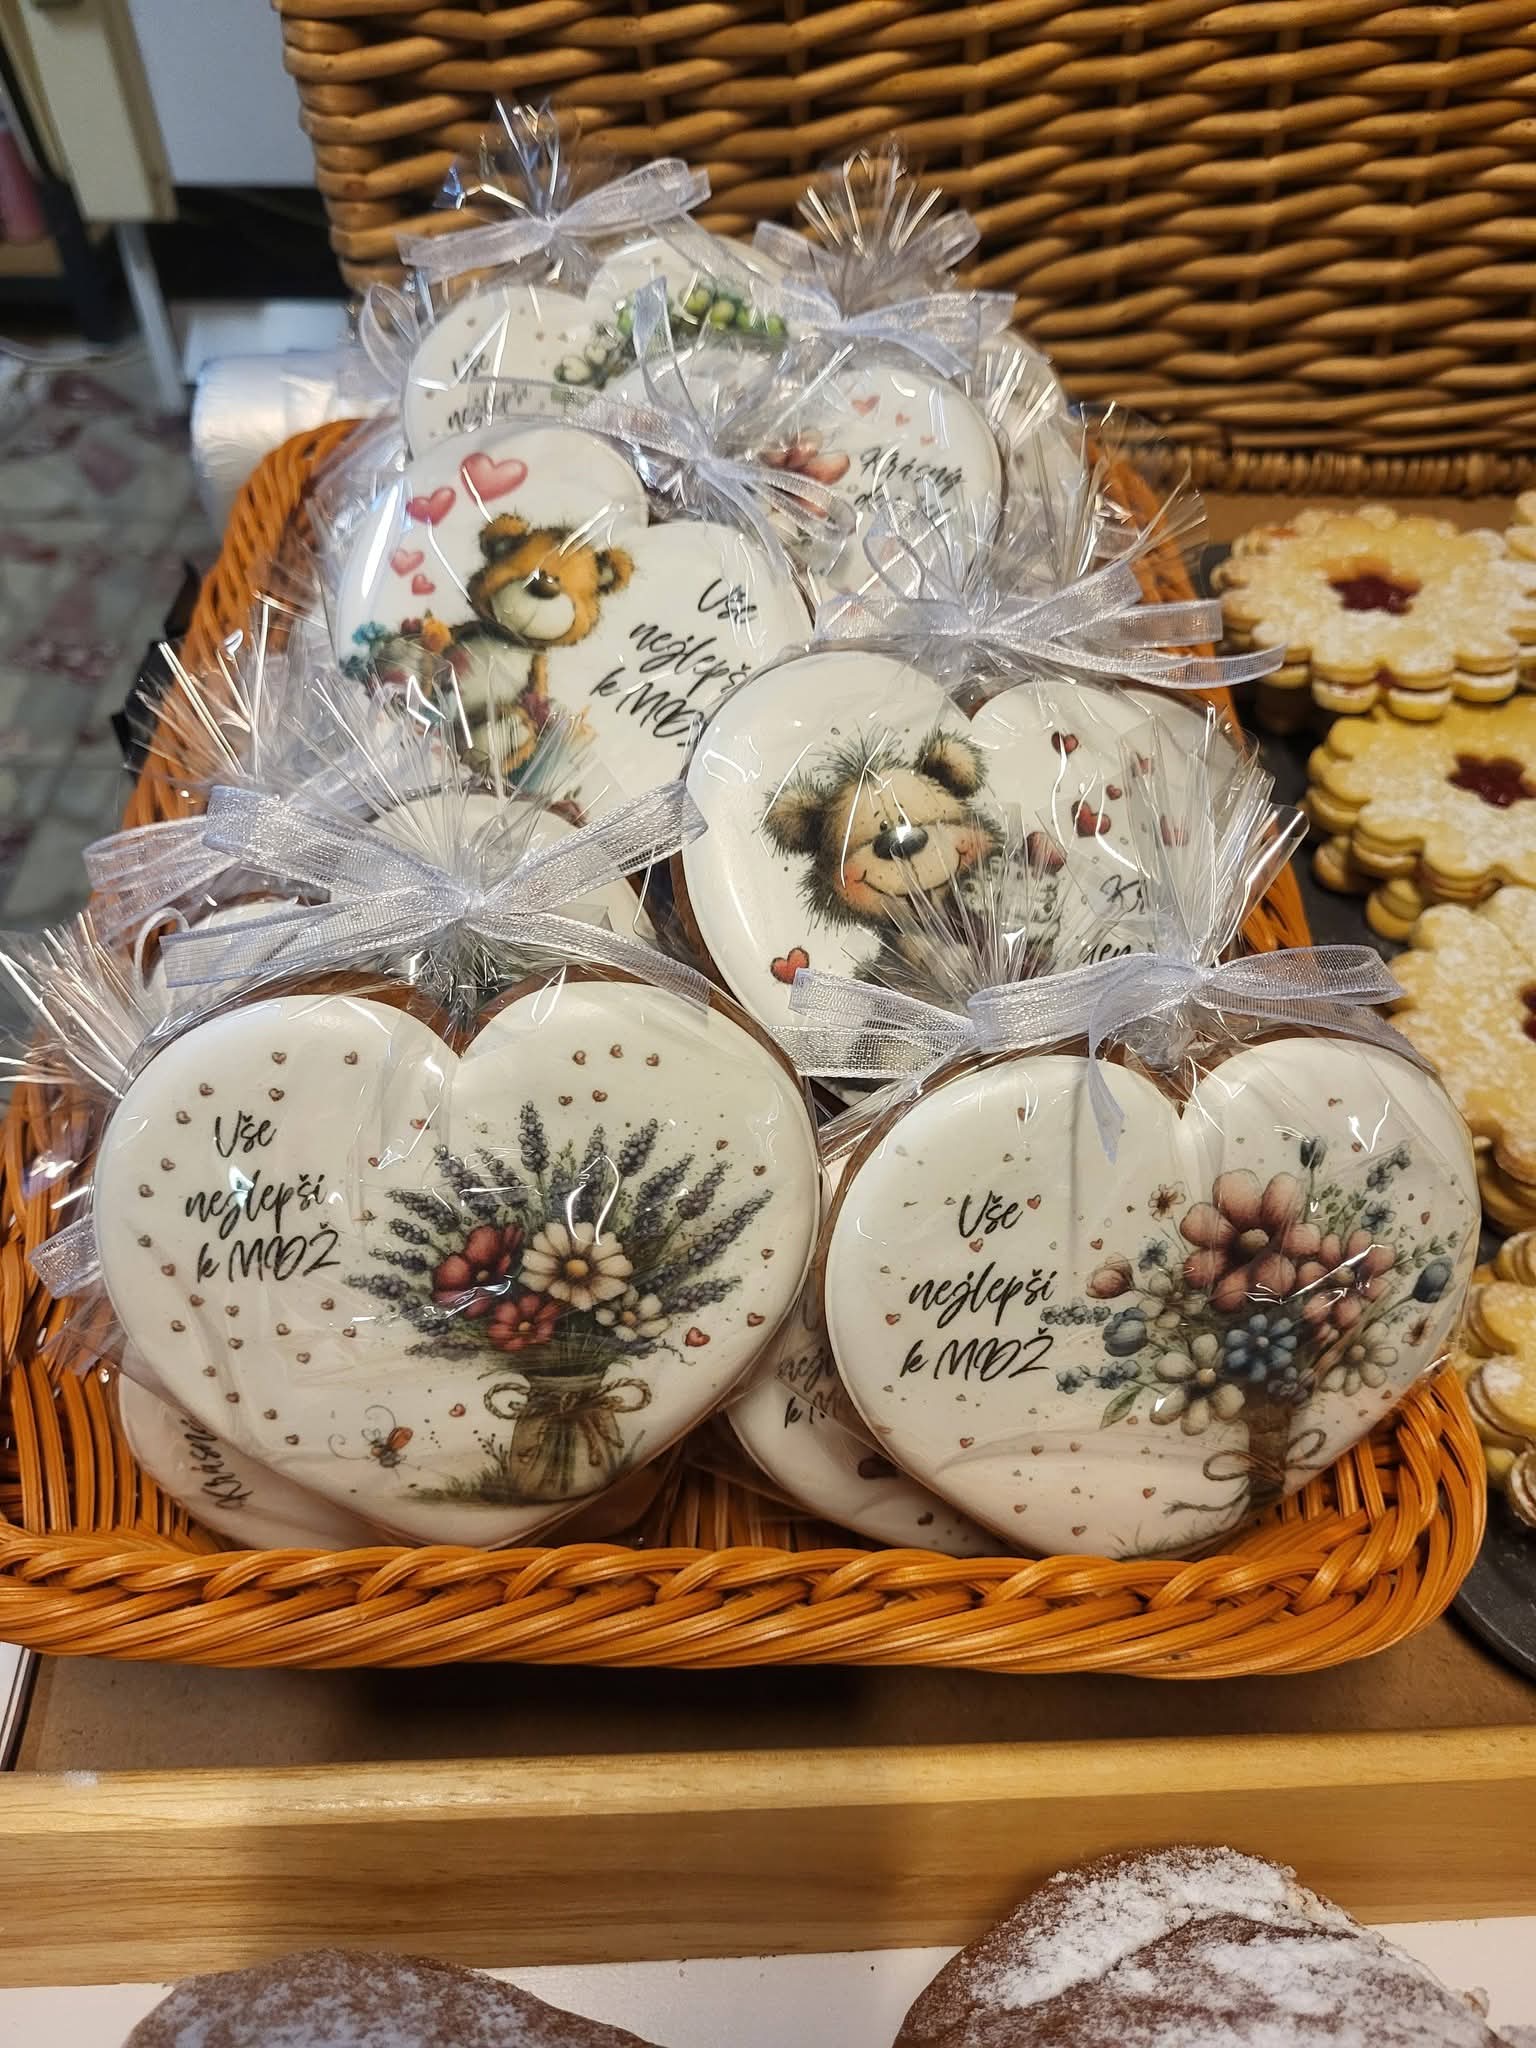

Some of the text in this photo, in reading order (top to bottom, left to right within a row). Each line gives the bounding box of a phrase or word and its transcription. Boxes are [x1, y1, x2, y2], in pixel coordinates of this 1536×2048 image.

[628, 623, 751, 698] nejlepš
[589, 666, 705, 748] k MD
[214, 1110, 278, 1158] Vše
[185, 1169, 329, 1240] nejlepší
[958, 1189, 1024, 1239] Vše
[196, 1221, 342, 1284] k MDŽ
[908, 1260, 1058, 1329] nejlepší
[899, 1326, 1055, 1383] k MDŽ
